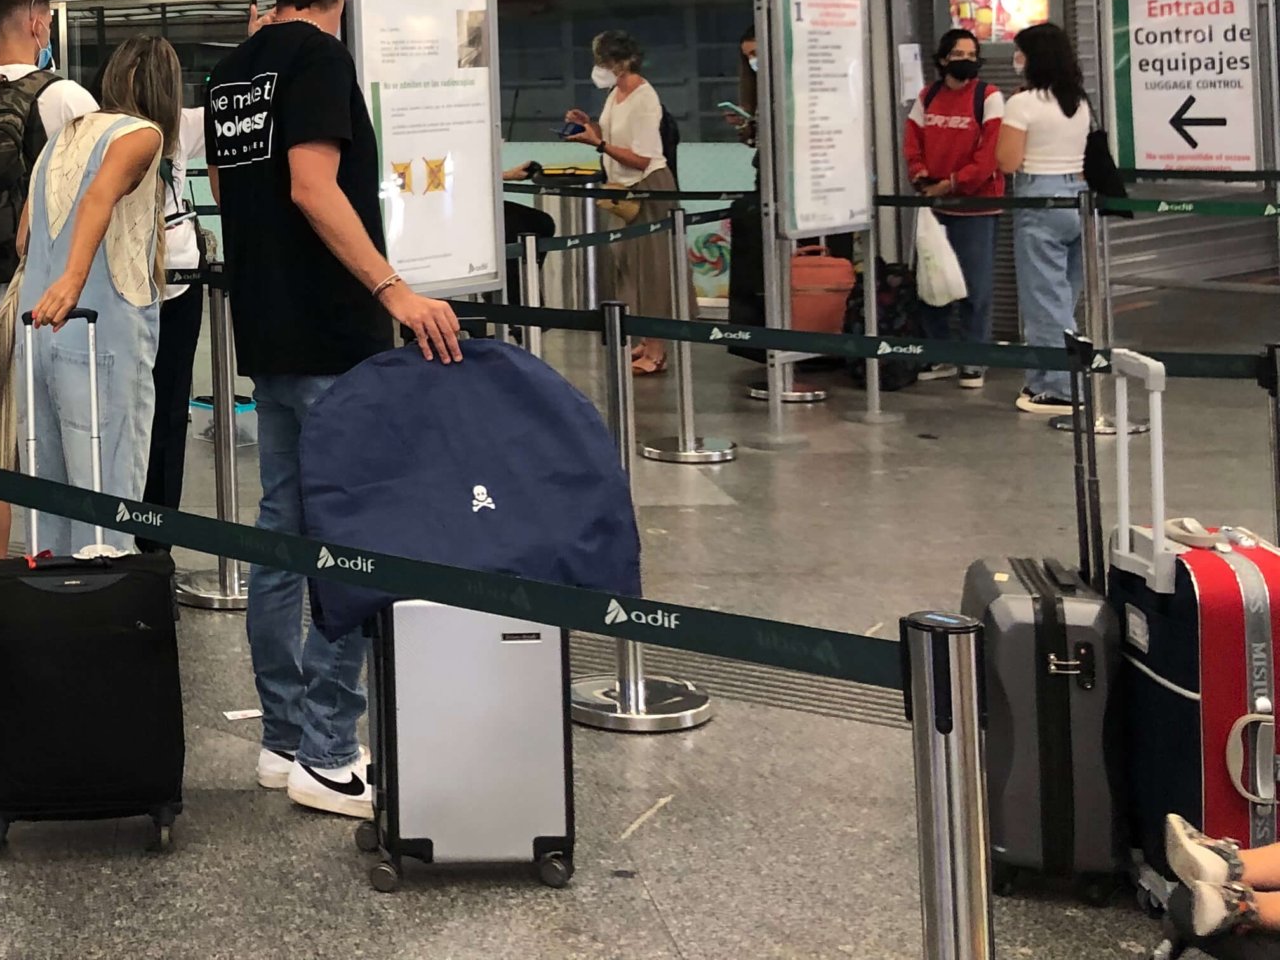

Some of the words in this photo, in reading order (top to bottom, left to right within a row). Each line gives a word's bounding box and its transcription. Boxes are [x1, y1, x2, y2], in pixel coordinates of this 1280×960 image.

[1134, 24, 1214, 46] Control
[1223, 23, 1251, 43] de
[1138, 50, 1251, 76] equipajes
[1144, 80, 1192, 91] LUGGAGE
[1196, 79, 1244, 90] CONTROL
[723, 330, 752, 340] adif
[893, 343, 925, 355] adif
[131, 511, 165, 527] adif
[336, 555, 376, 574] adif
[630, 609, 681, 630] adif
